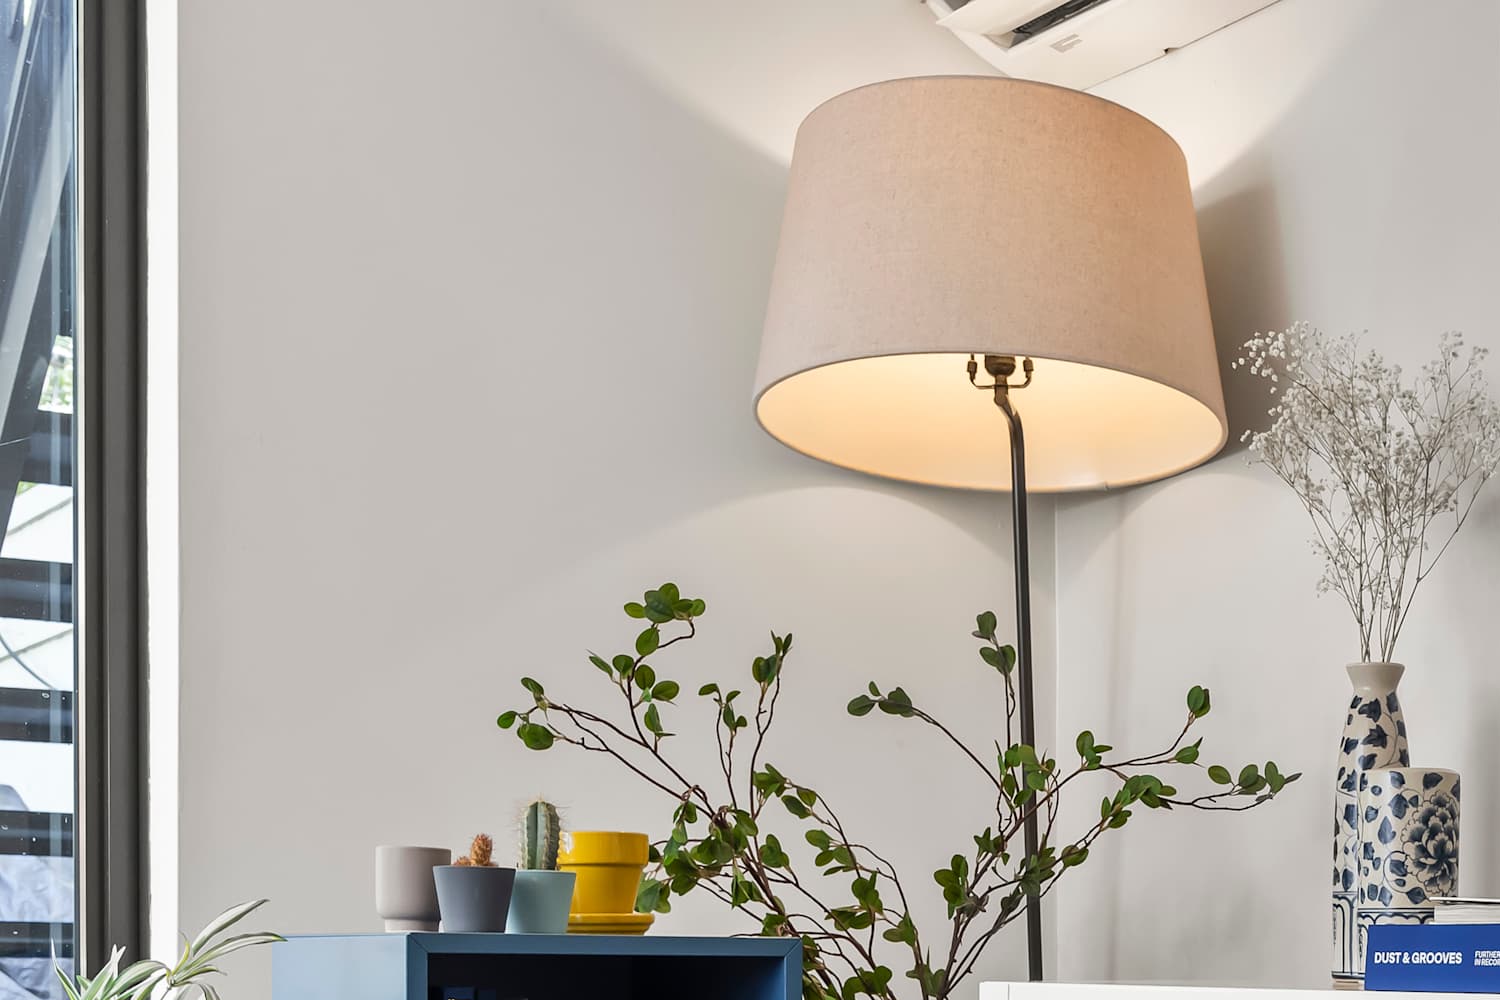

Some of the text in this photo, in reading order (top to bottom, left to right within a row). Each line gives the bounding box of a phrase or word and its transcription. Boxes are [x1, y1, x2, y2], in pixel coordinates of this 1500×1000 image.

[1374, 952, 1463, 964] DUST & GROOVES
[1474, 950, 1500, 959] FURTHER
[1474, 958, 1481, 967] IN
